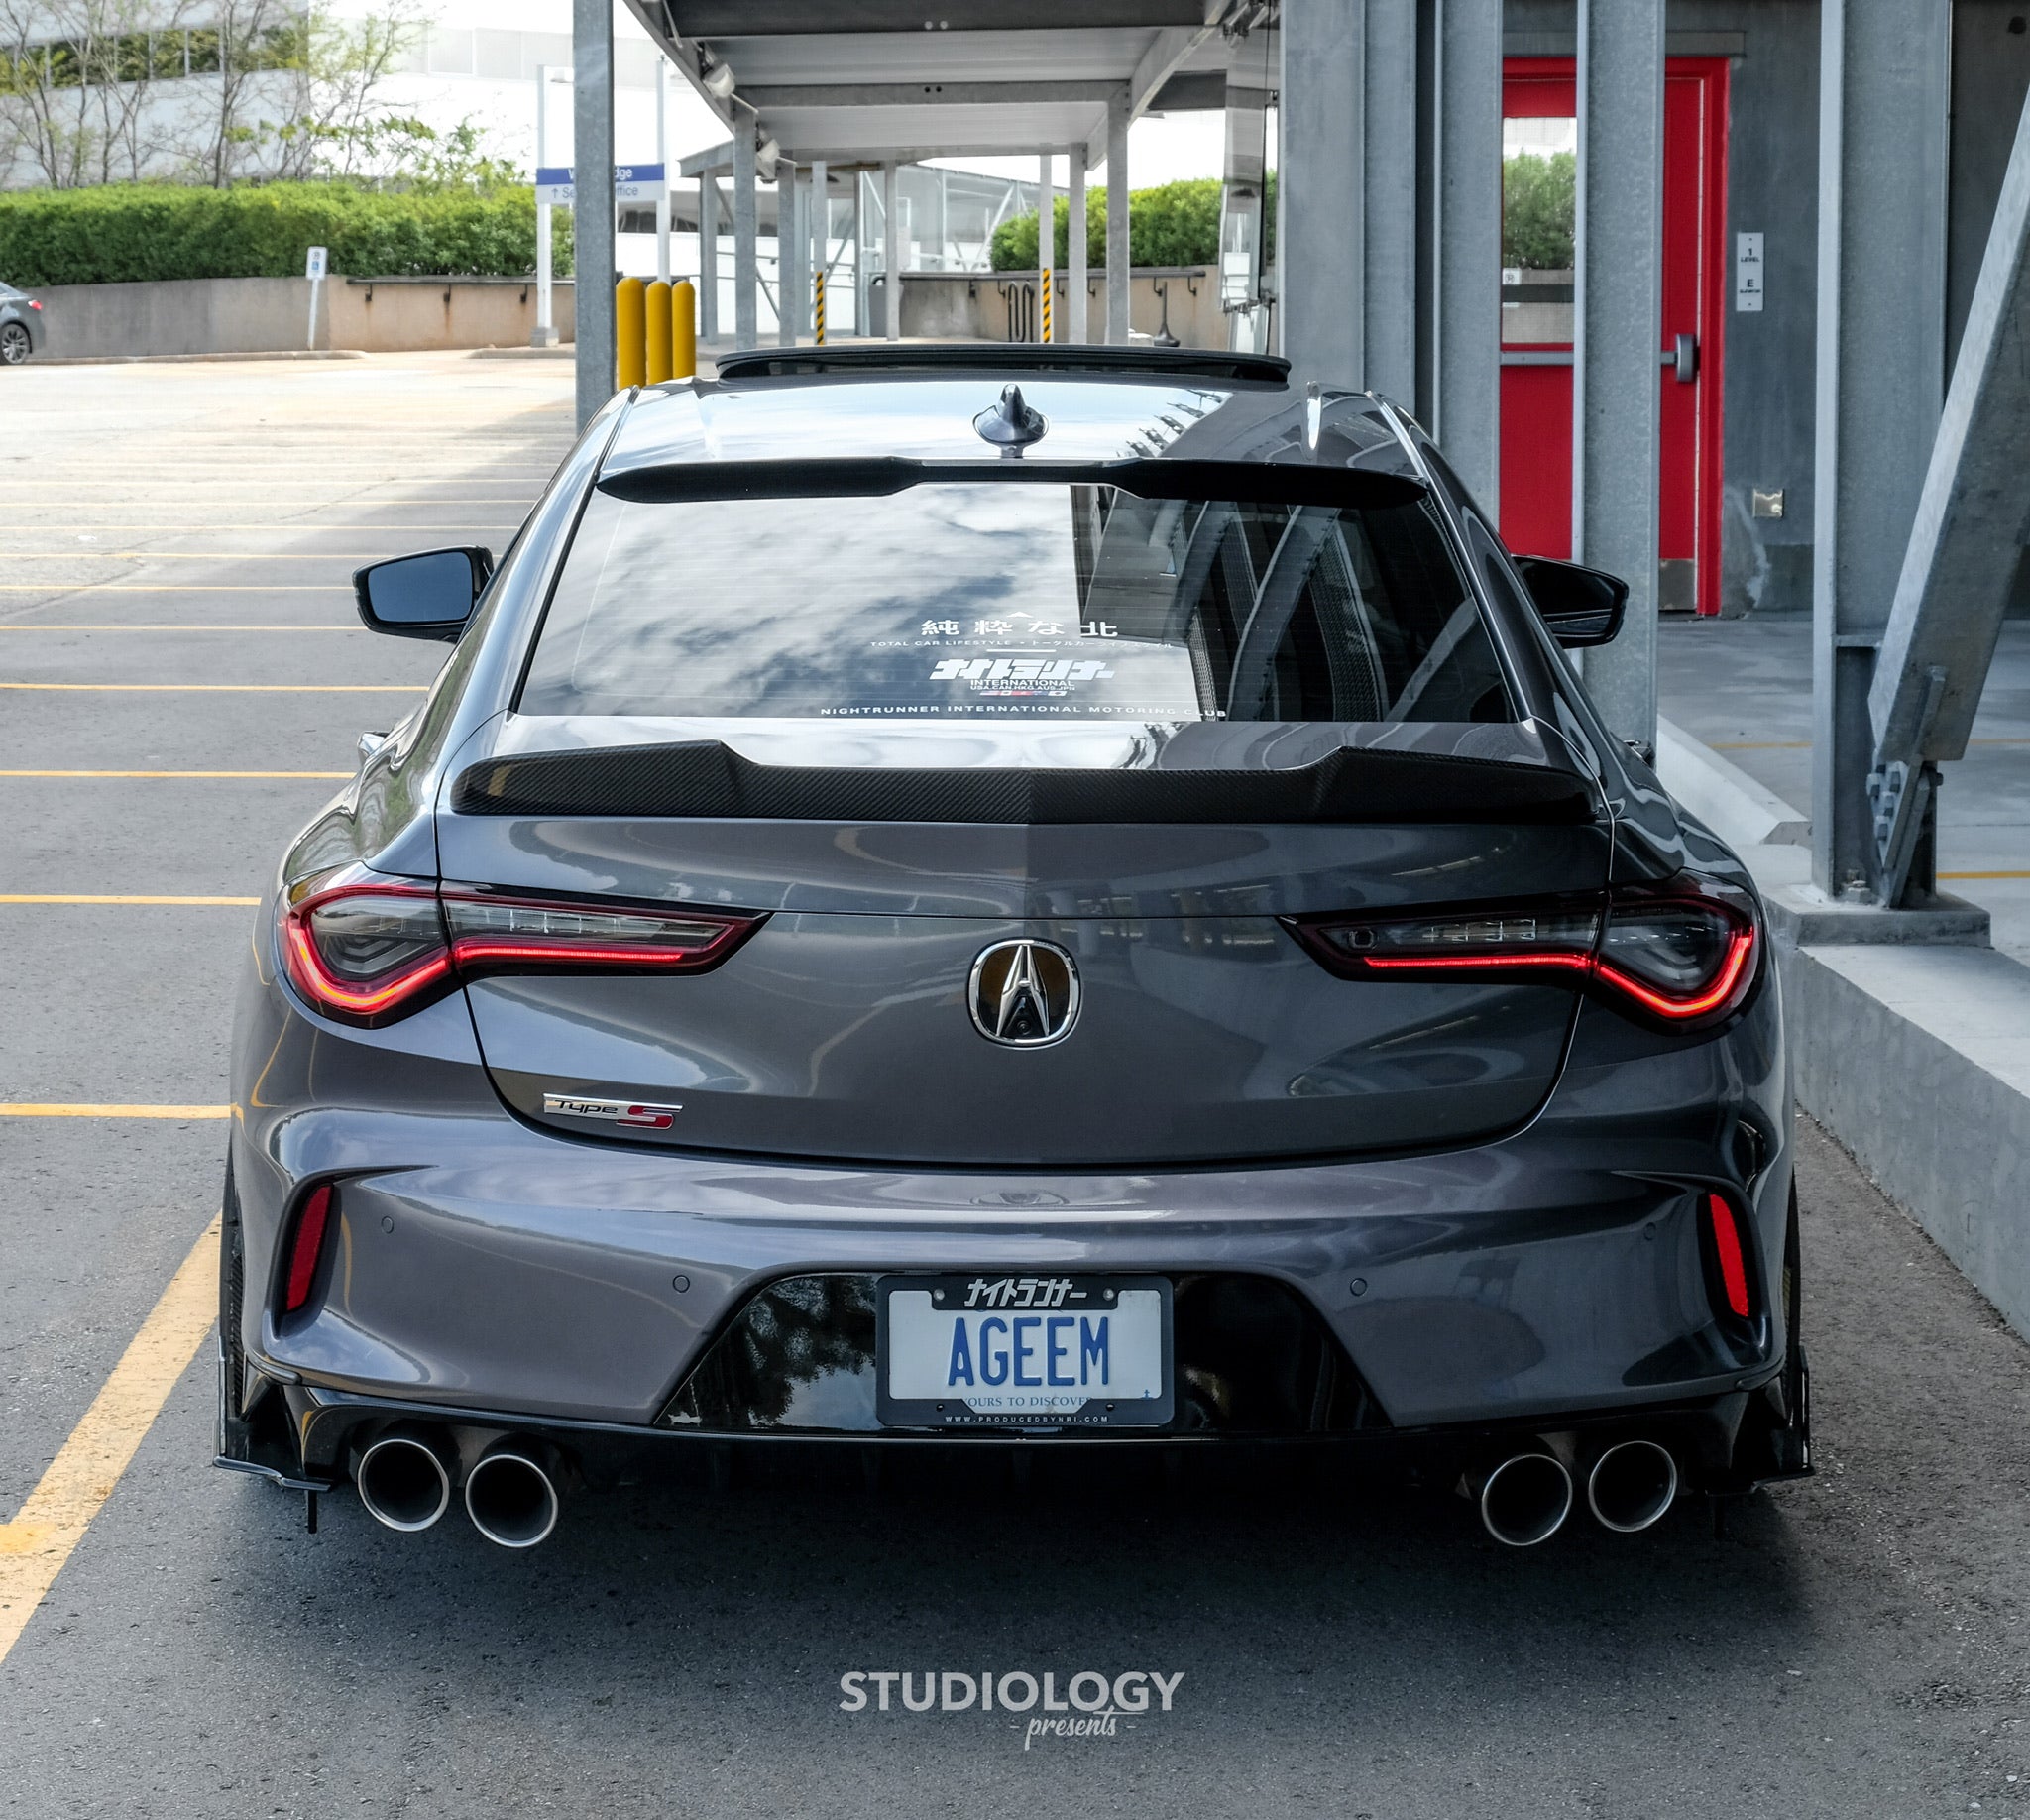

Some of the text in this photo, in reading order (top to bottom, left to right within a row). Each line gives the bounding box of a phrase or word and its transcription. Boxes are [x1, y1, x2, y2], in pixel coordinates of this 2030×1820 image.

[615, 186, 639, 197] ffice
[1747, 279, 1754, 287] E
[821, 705, 940, 715] NIGHTRUNNER
[1088, 705, 1177, 715] MOTORING
[555, 1099, 674, 1130] Type S
[948, 1316, 1109, 1387] AGEEM
[964, 1397, 1002, 1407] OURS
[1007, 1397, 1026, 1407] TO
